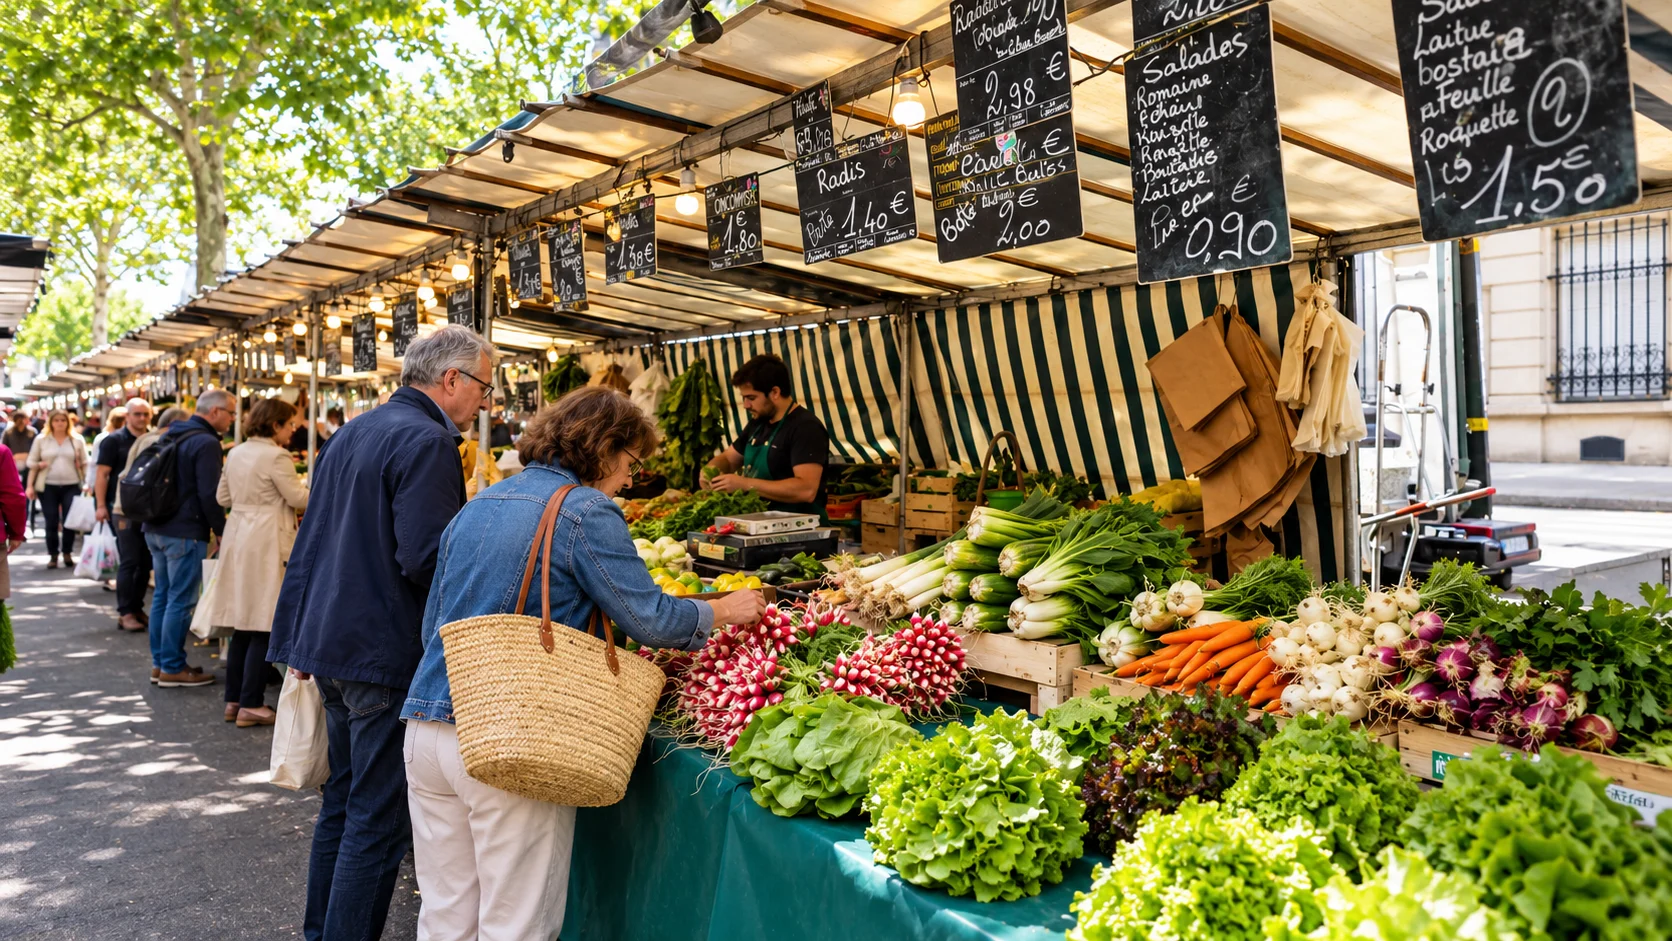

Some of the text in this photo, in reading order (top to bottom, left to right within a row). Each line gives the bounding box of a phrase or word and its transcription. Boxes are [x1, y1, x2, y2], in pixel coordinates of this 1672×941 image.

[1143, 32, 1249, 84] Salades
[1414, 19, 1495, 60] Laitue
[985, 70, 1036, 119] 2,98
[1046, 51, 1067, 81] €
[1137, 74, 1212, 110] Romaine
[1436, 68, 1515, 114] Feuille
[1041, 128, 1070, 156] €
[1420, 99, 1519, 156] Roquette
[816, 161, 866, 194] Radis
[1017, 187, 1039, 207] €
[1231, 174, 1257, 203] €
[1461, 145, 1607, 225] 1.50
[736, 210, 747, 227] €
[841, 196, 888, 239] 1,40
[890, 190, 909, 215] €
[997, 199, 1051, 249] 2,00
[1185, 212, 1277, 265] 0,90
